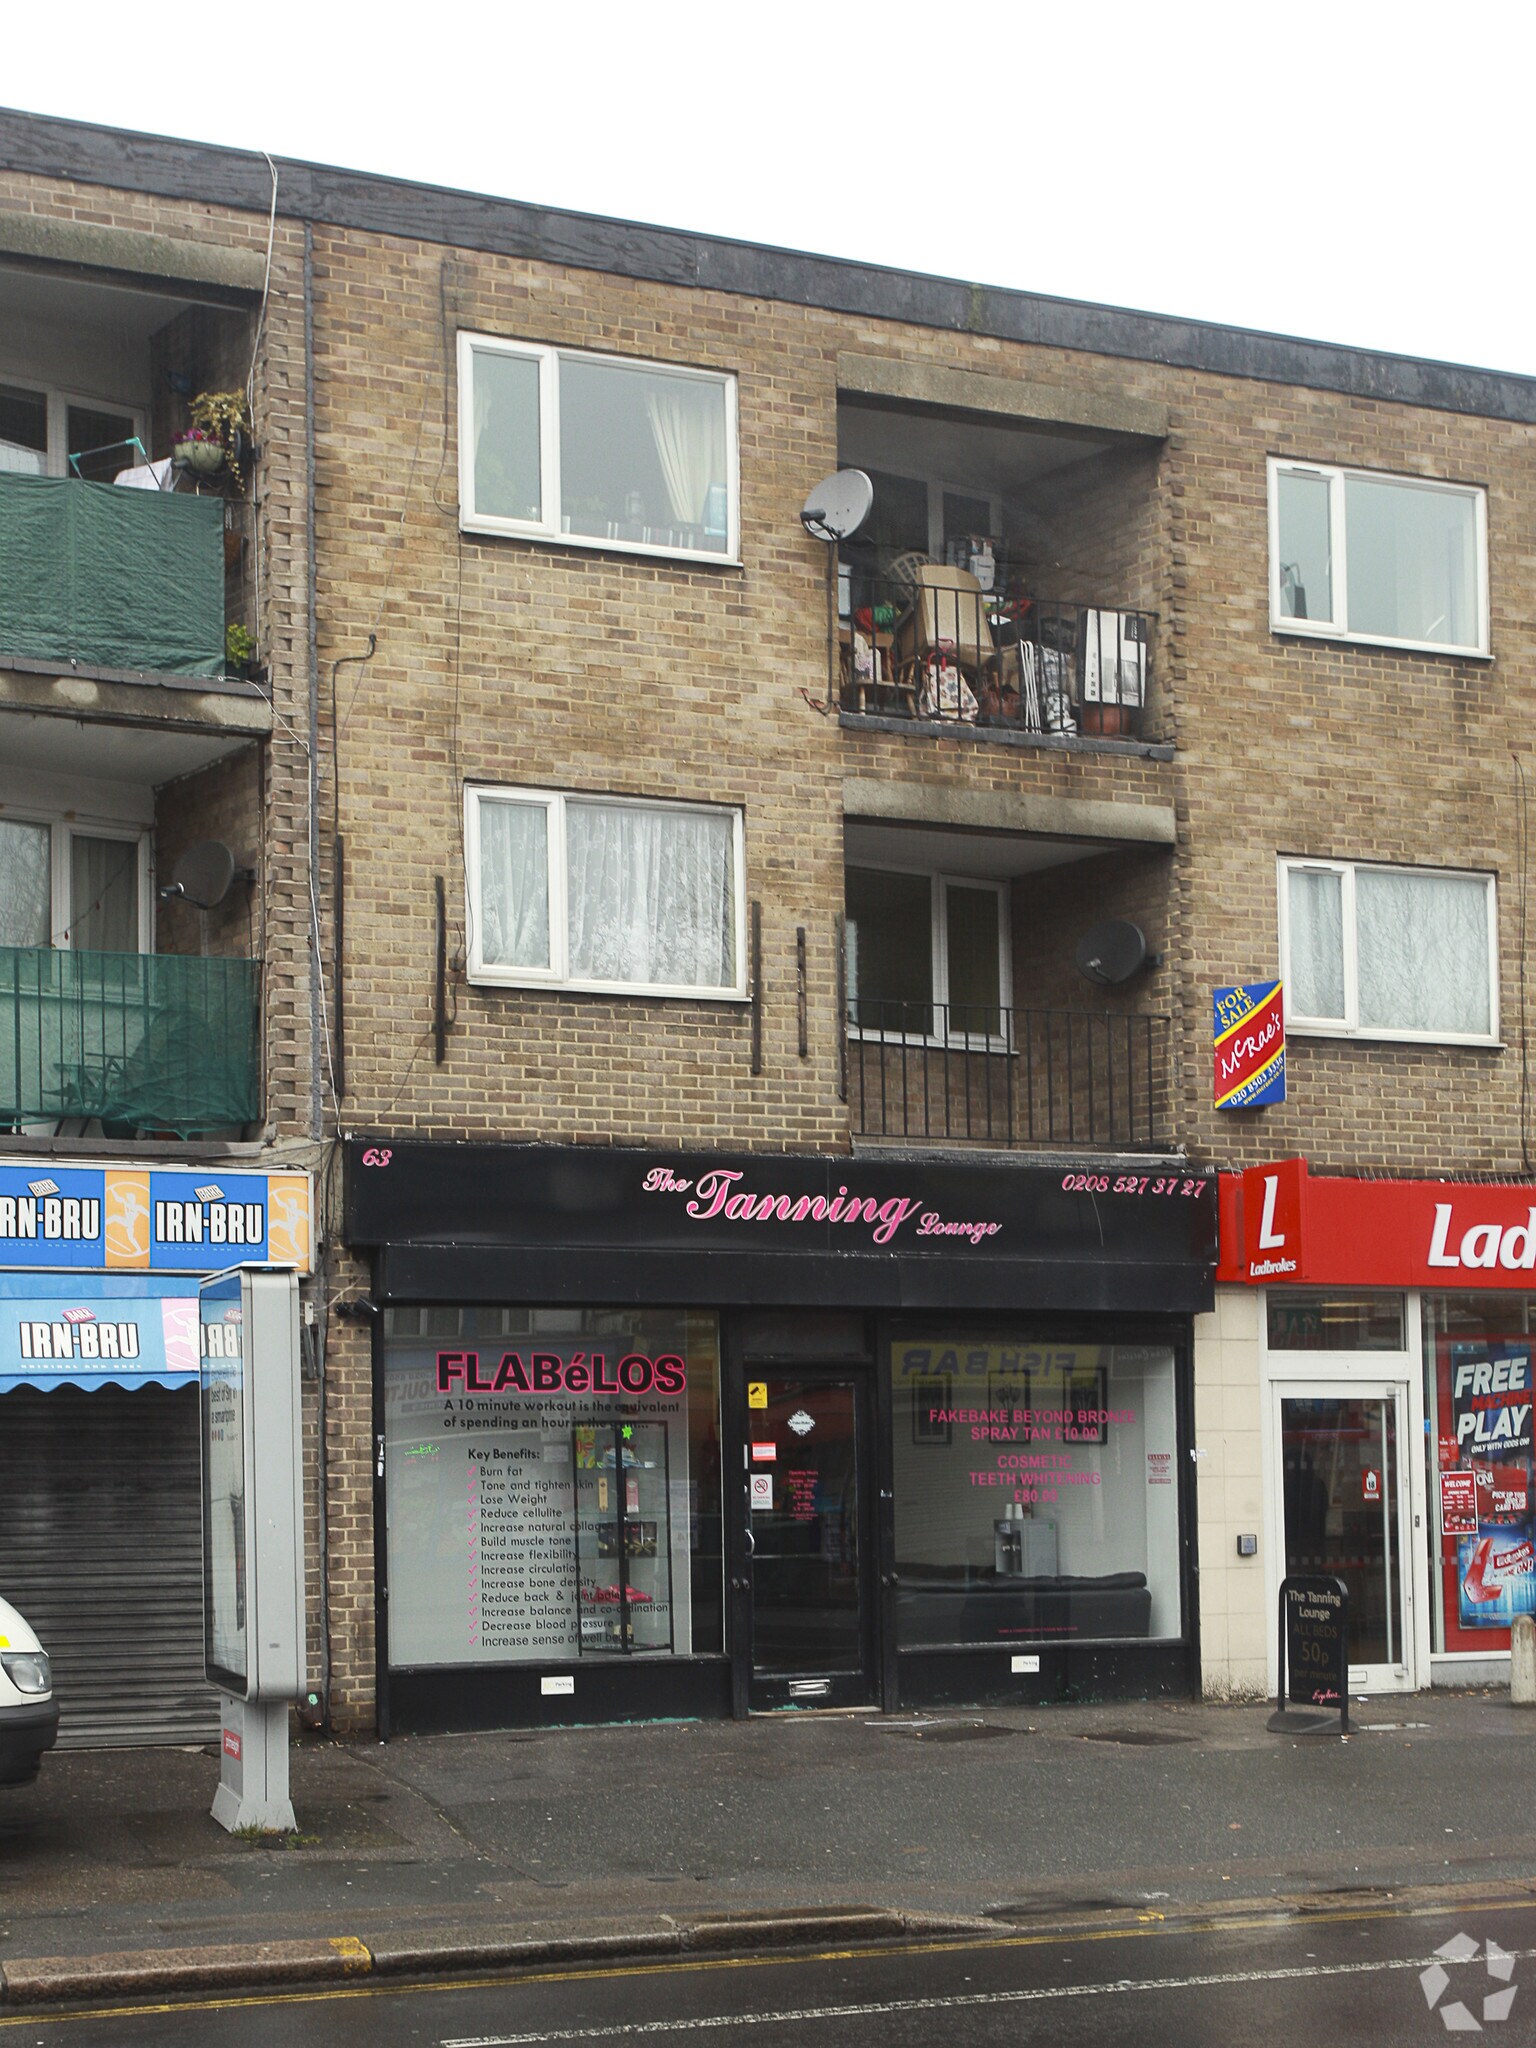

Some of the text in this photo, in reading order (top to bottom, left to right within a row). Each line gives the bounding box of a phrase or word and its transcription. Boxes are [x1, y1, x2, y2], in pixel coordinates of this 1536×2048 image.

[1217, 987, 1247, 1015] FOR
[1221, 995, 1255, 1029] SALE
[1230, 1088, 1248, 1106] 020
[361, 1147, 393, 1167] 63
[1061, 1174, 1207, 1199] 0208 527 37 27
[642, 1167, 1003, 1245] The Tanning Lounge
[1259, 1175, 1285, 1250] L
[155, 1201, 264, 1245] IRN-BRU
[1427, 1203, 1536, 1269] Lad
[1249, 1257, 1296, 1277] Ladbrokes
[19, 1321, 140, 1359] IRN-BRU
[437, 1351, 686, 1394] FLABéLOS
[1455, 1357, 1528, 1398] FREE
[444, 1400, 454, 1411] A
[458, 1400, 474, 1411] 10
[477, 1399, 521, 1411] minute
[526, 1400, 576, 1411] workout
[580, 1400, 589, 1411] is
[593, 1400, 611, 1411] the
[614, 1400, 680, 1415] equivalent
[1471, 1389, 1531, 1411] MACHINE
[444, 1416, 457, 1428] of
[461, 1416, 518, 1430] spending
[522, 1418, 538, 1428] an
[541, 1416, 569, 1428] hour
[929, 1409, 1136, 1424] FAKEBAKE BEYOND BRONZE
[971, 1427, 1099, 1441] SPRAY TAN £10.00
[1471, 1443, 1487, 1453] ONLY
[1487, 1441, 1503, 1451] WITH
[468, 1449, 540, 1461] Key Benefits:
[997, 1455, 1072, 1469] COSMETIC
[480, 1466, 523, 1476] Burn fat
[969, 1472, 1101, 1486] TEETH WHITENING
[1476, 1472, 1494, 1486] ON!
[481, 1481, 505, 1490] Tone
[510, 1480, 531, 1490] and
[535, 1480, 570, 1493] tighten
[480, 1494, 548, 1506] Lose Weight
[1013, 1489, 1058, 1502] £80.00
[480, 1508, 563, 1518] Reduce cellulite
[480, 1522, 524, 1532] Increase
[528, 1522, 565, 1532] natural
[481, 1537, 571, 1546] Build muscle tone
[481, 1550, 577, 1562] Increase flexibility
[481, 1565, 525, 1574] Increase
[481, 1579, 525, 1589] Increase
[529, 1578, 555, 1588] bone
[481, 1593, 520, 1603] Reduce
[524, 1592, 549, 1602] back
[556, 1591, 564, 1601] &
[1289, 1590, 1341, 1608] The Tanning
[481, 1607, 525, 1617] Increase
[529, 1606, 572, 1616] balance
[1299, 1606, 1331, 1622] Lounge
[482, 1618, 614, 1632] Decrease blood pessure
[1294, 1623, 1338, 1639] ALL BEDS
[482, 1635, 529, 1646] Increase
[532, 1636, 565, 1646] sense
[567, 1634, 579, 1645] of
[581, 1633, 601, 1644] well
[1302, 1640, 1329, 1668] 50p
